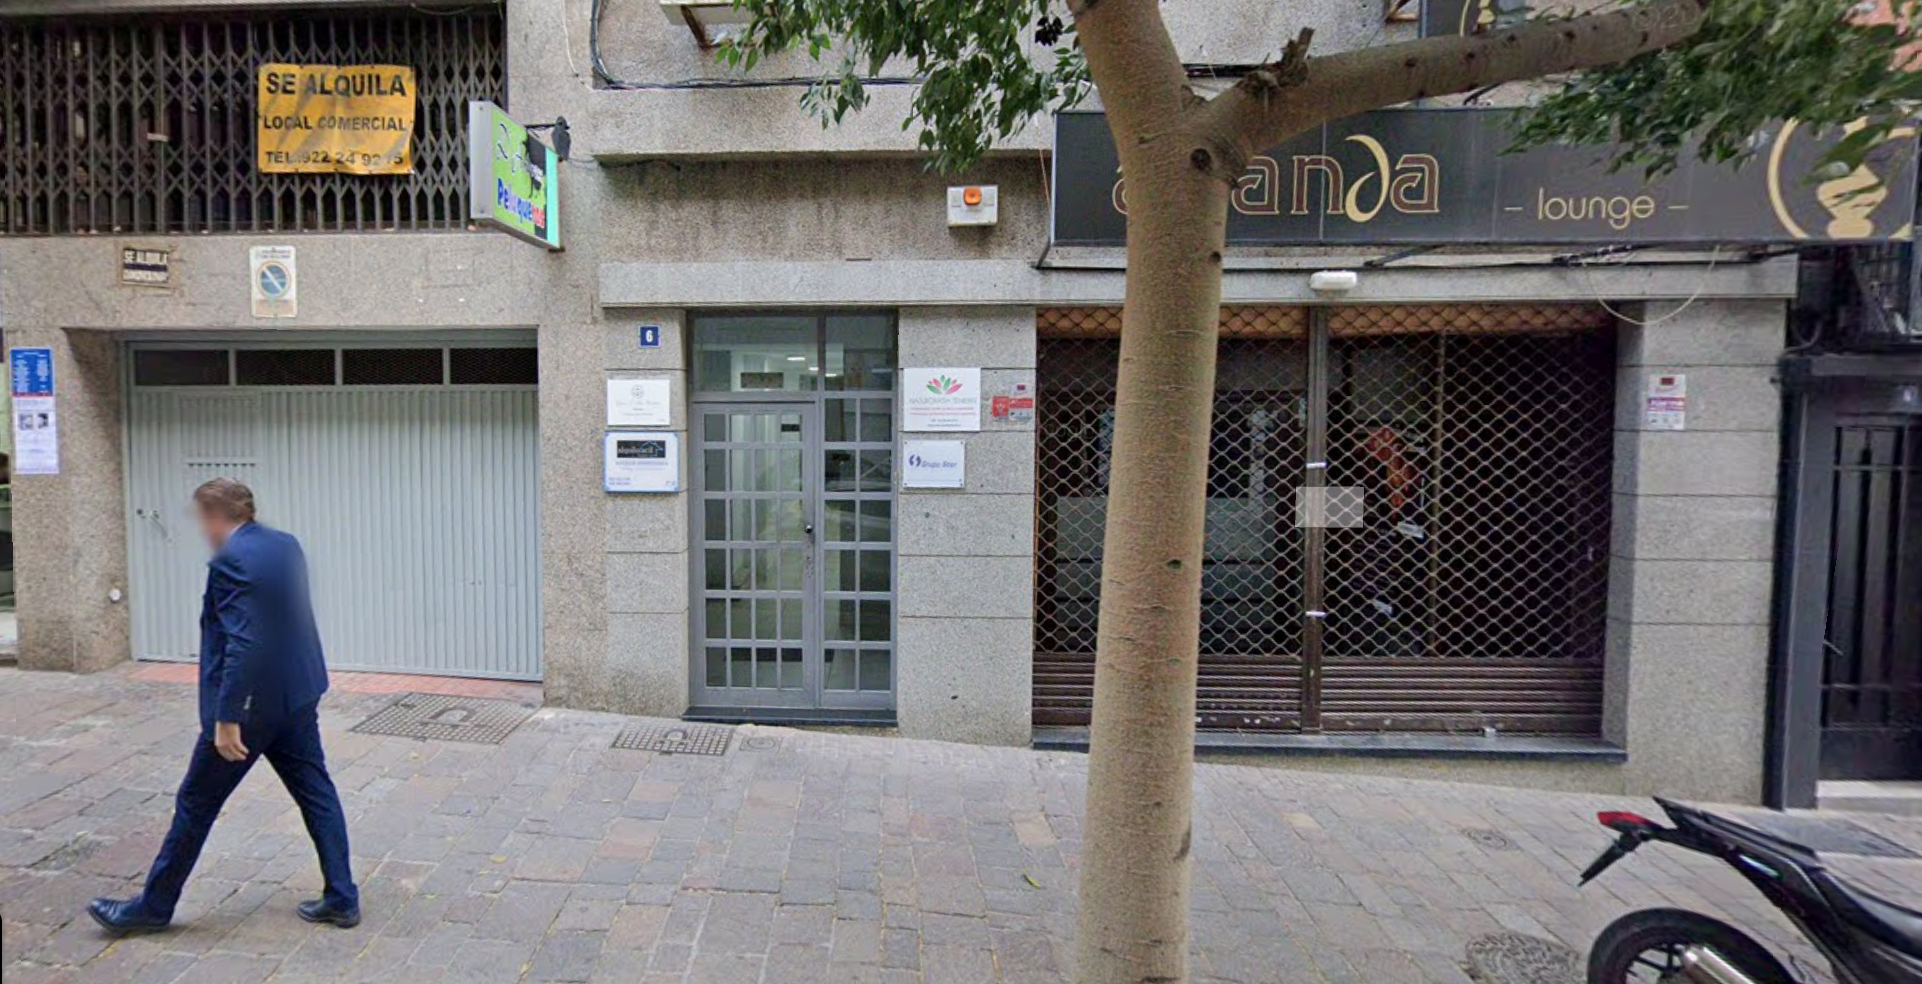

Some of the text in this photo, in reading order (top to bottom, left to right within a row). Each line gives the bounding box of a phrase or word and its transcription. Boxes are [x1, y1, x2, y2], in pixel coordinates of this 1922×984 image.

[266, 72, 407, 97] SE ALQUILA
[263, 115, 407, 132] LOCAL COMERCIAL
[361, 152, 382, 167] 92
[1537, 187, 1655, 230] lounge
[645, 329, 654, 343] 6
[920, 461, 940, 469] Grupo
